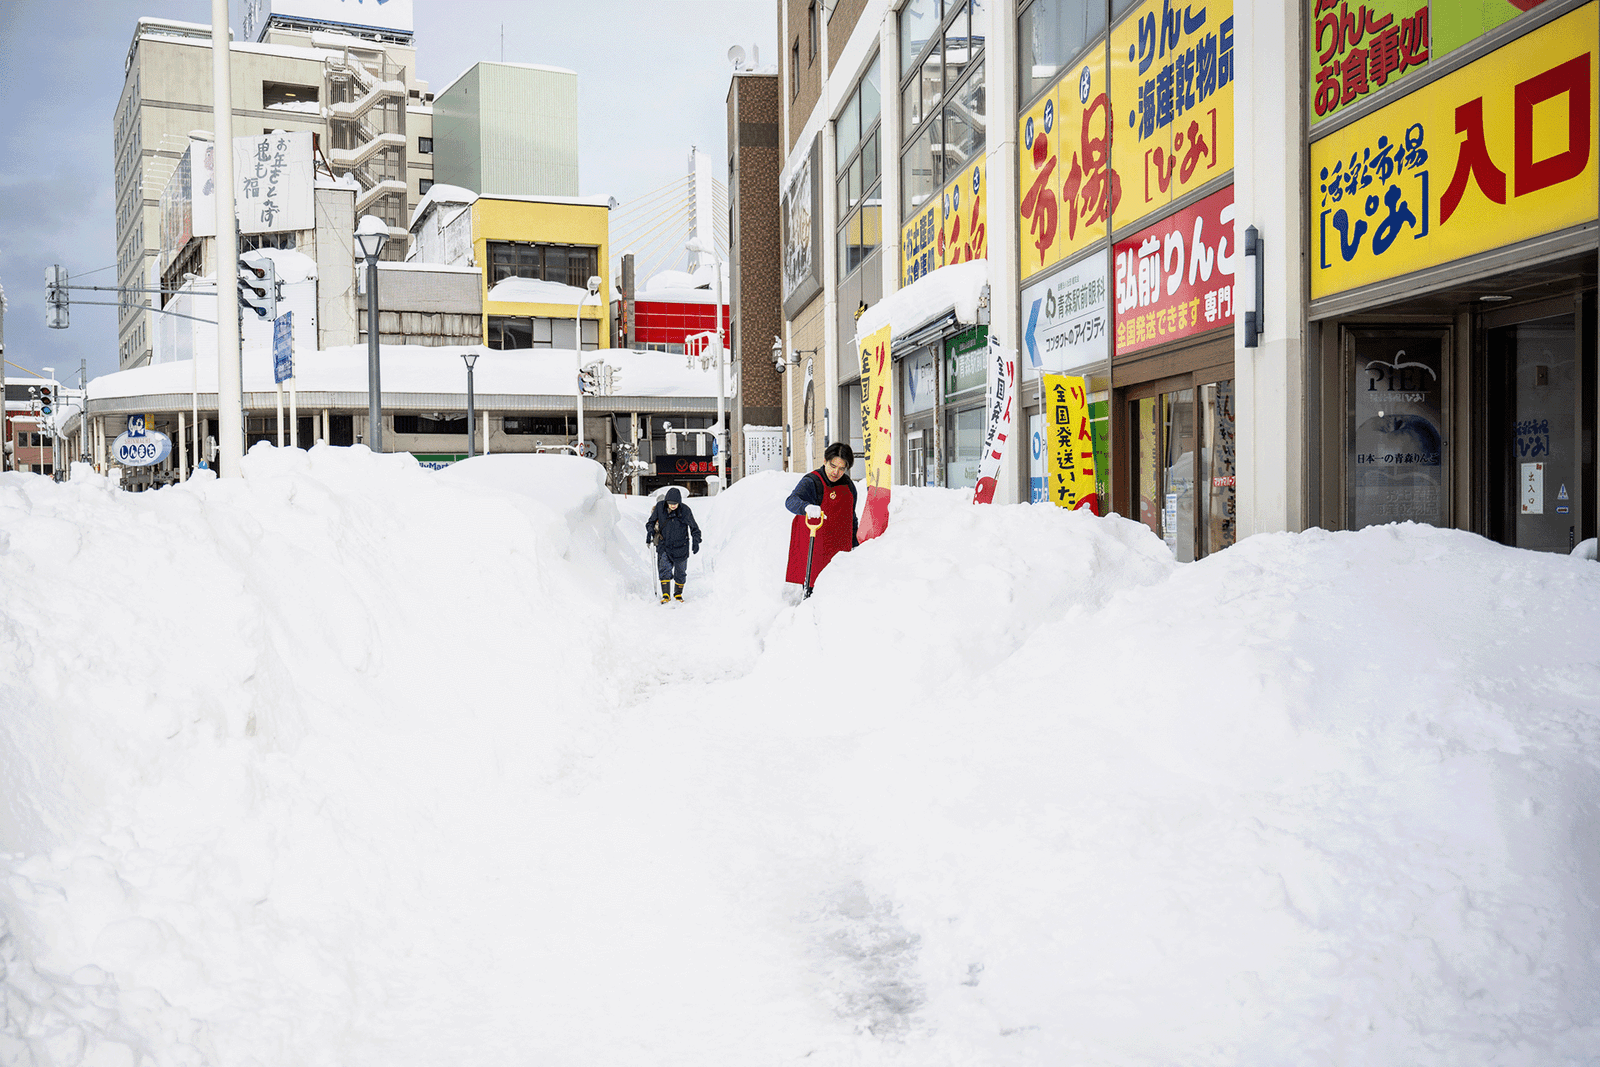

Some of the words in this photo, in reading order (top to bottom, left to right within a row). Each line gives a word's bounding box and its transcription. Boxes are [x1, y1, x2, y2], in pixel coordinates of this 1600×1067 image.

[1314, 6, 1429, 117] お食事処
[1025, 66, 1091, 151] いちば
[1439, 51, 1592, 227] 入口
[243, 177, 260, 199] 福
[261, 138, 291, 228] お年をとれば
[1021, 93, 1123, 267] 市場
[1057, 275, 1106, 320] 青森駅前眼科
[1116, 296, 1200, 349] 全国発送できます
[1204, 284, 1235, 322] 専門
[119, 443, 156, 460] しんまち
[1357, 452, 1439, 464] 日本一の青森りんご
